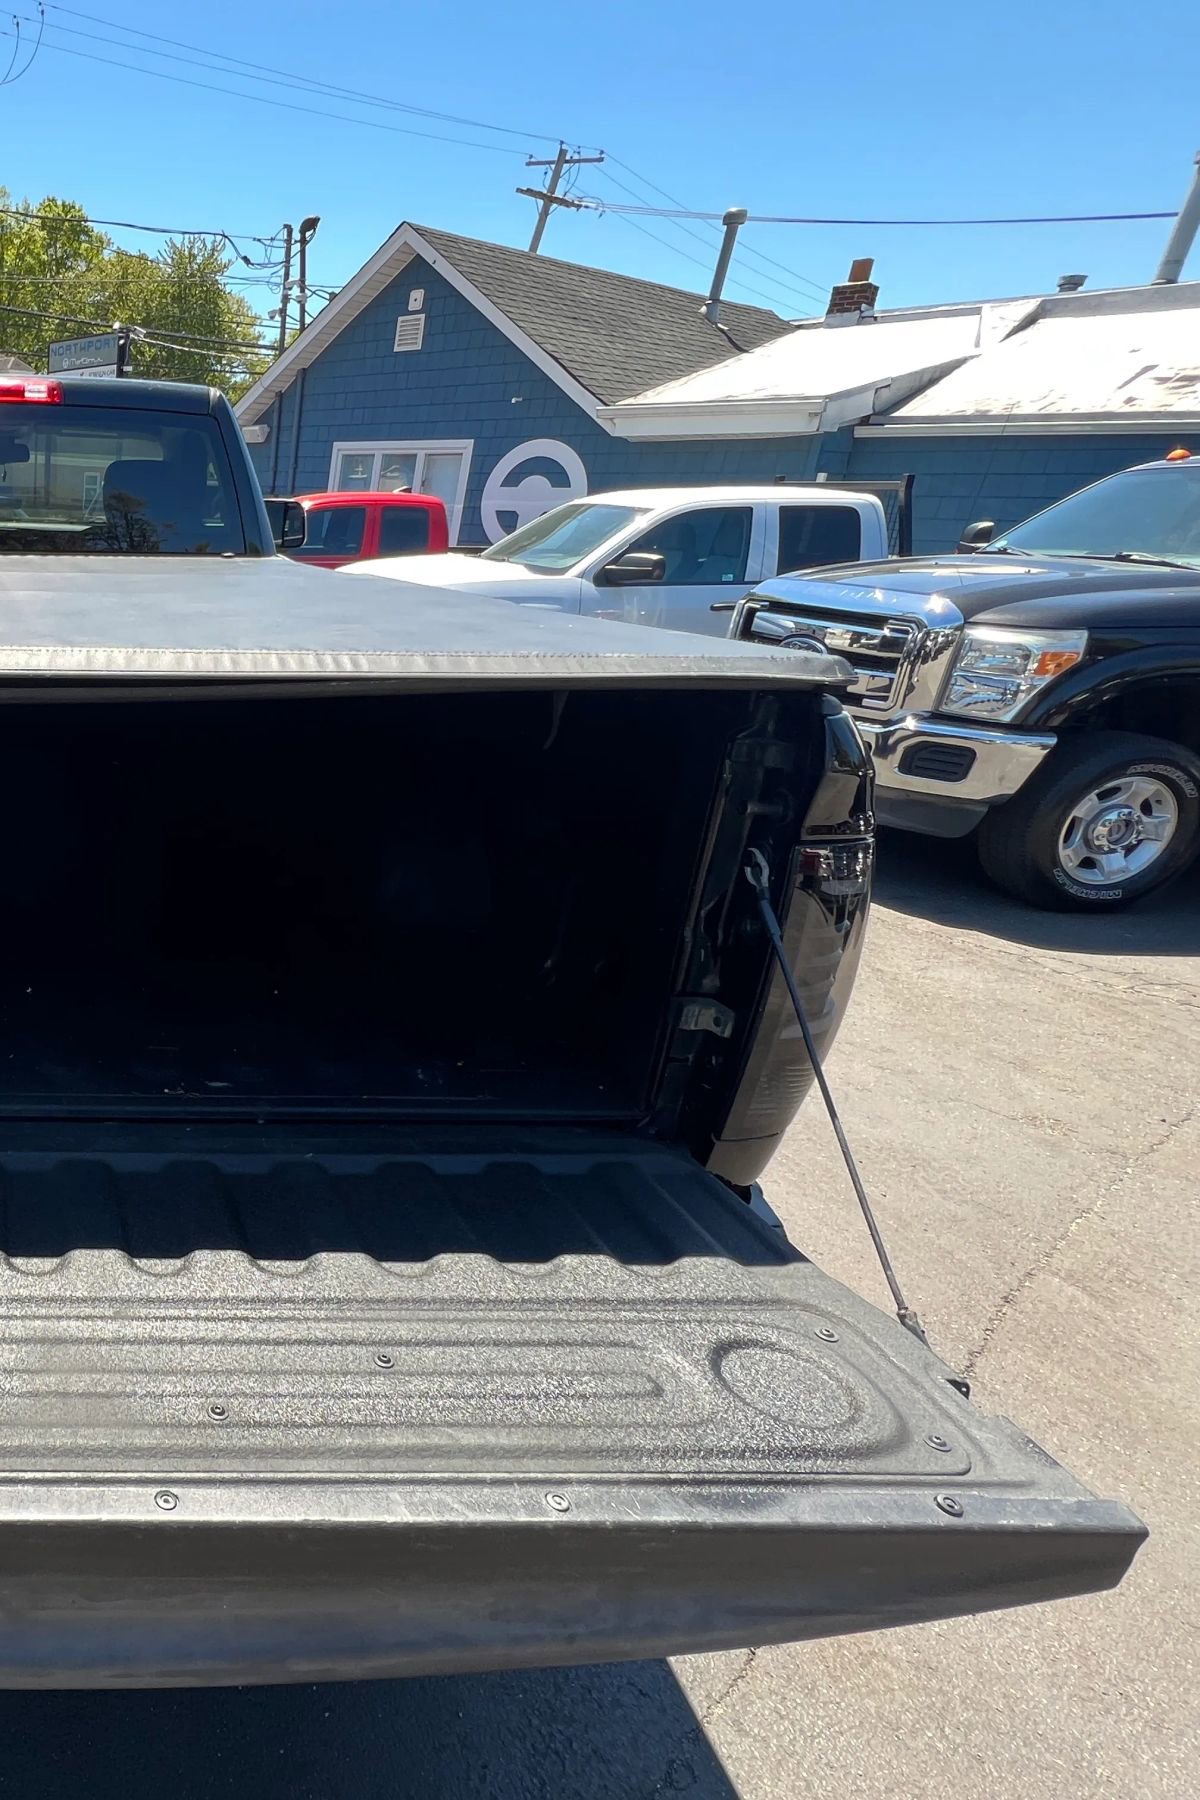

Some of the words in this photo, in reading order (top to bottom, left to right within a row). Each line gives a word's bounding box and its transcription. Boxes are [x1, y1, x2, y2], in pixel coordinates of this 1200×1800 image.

[51, 336, 116, 357] NORTHPORT
[1126, 763, 1199, 798] MICHELIN
[1052, 867, 1123, 899] MICHELIN
